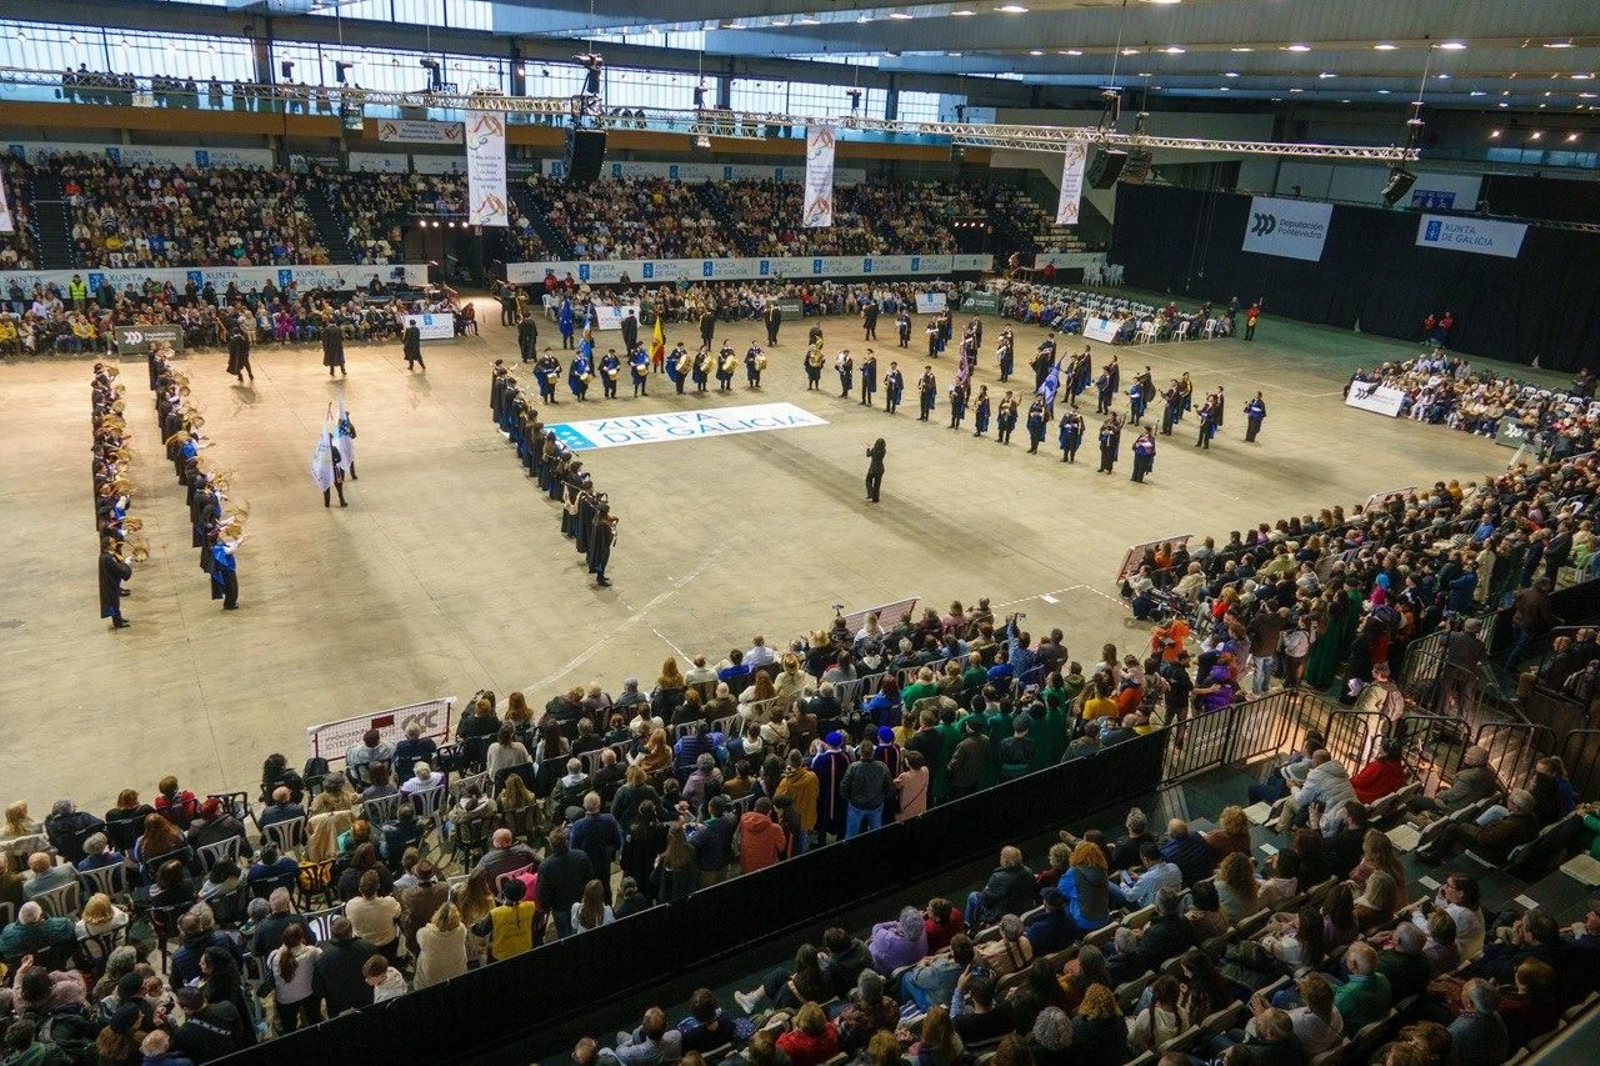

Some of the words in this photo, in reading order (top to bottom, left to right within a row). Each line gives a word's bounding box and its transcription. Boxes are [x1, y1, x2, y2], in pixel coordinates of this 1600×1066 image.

[1279, 218, 1323, 231] Deputación
[1444, 223, 1476, 234] XUNTA
[1279, 227, 1322, 239] Pontevedra
[1441, 234, 1454, 242] DE
[1456, 235, 1493, 246] GALICIA
[109, 273, 144, 281] XUNTA
[205, 271, 239, 279] XUNTA
[294, 270, 327, 278] XUNTA
[588, 412, 721, 431] XUNTA
[603, 429, 657, 443] DE
[666, 414, 813, 437] GALICIA
